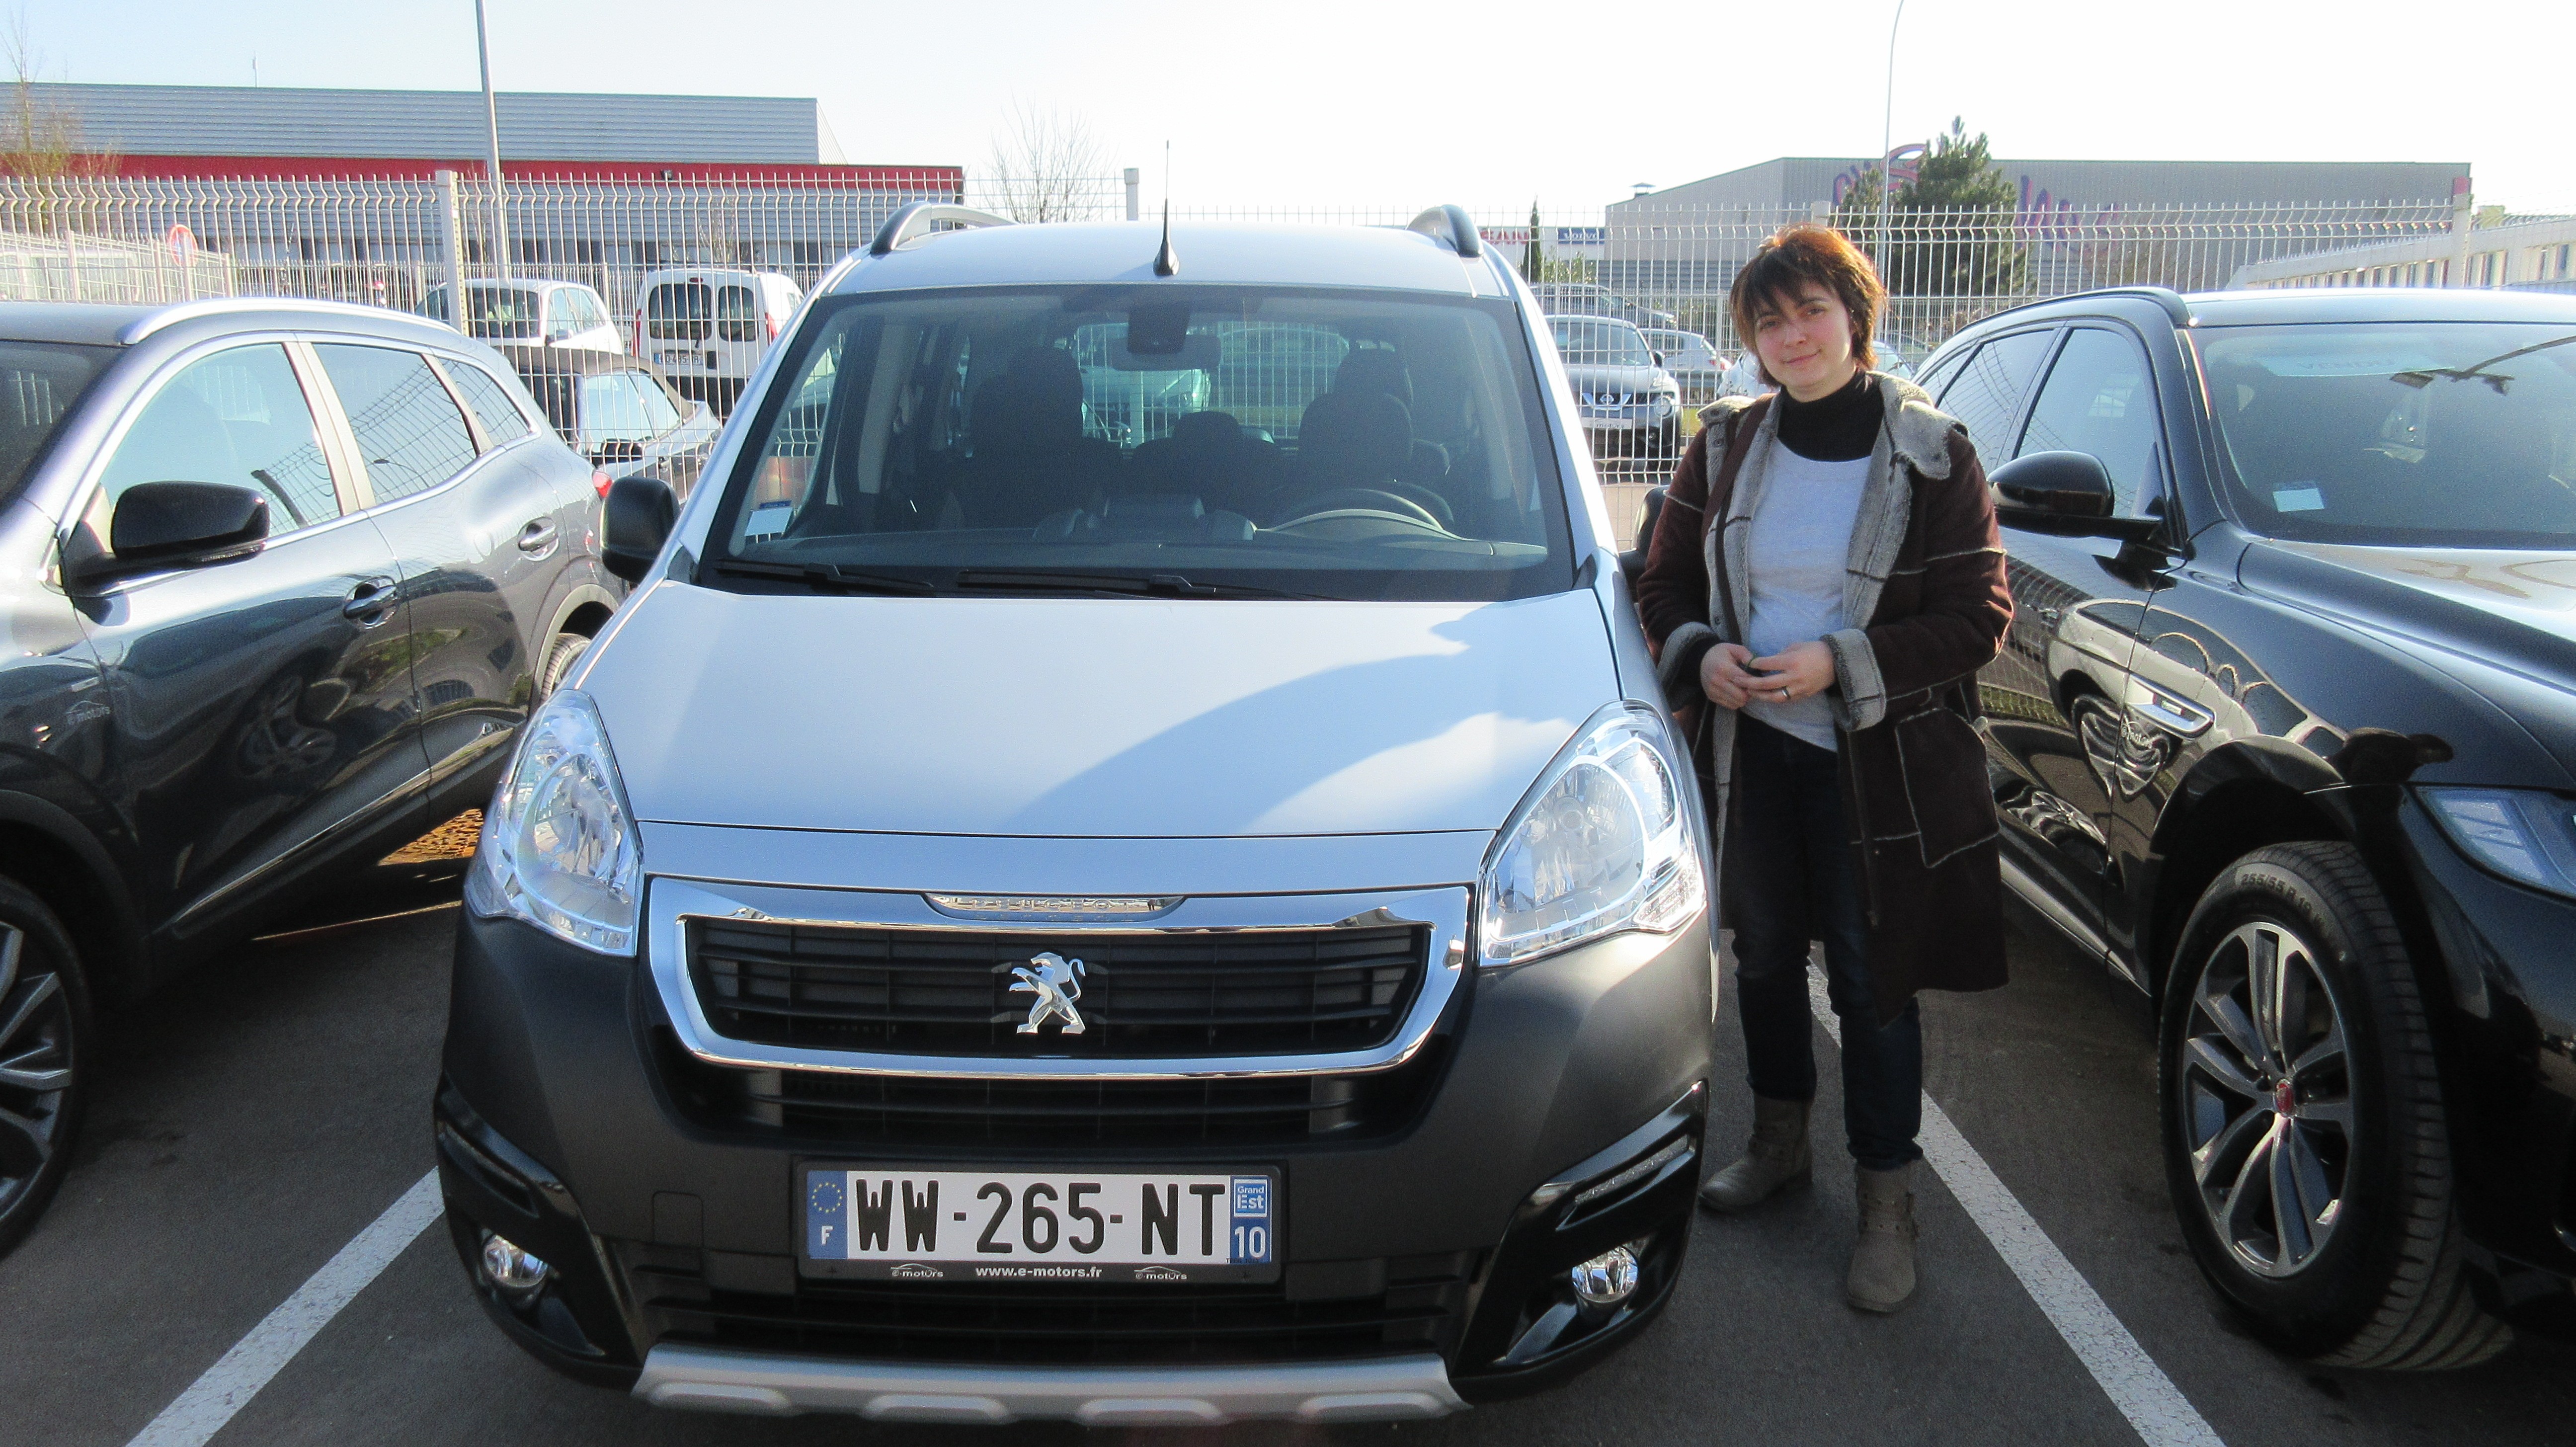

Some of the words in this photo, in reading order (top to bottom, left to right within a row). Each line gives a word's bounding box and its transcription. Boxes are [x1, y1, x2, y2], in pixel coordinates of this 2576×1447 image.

[1237, 1195, 1264, 1209] Est
[856, 1179, 1225, 1256] WW-265-NT
[821, 1225, 833, 1245] F
[1235, 1226, 1266, 1258] 10
[975, 1267, 1103, 1279] www.e-motors.fr
